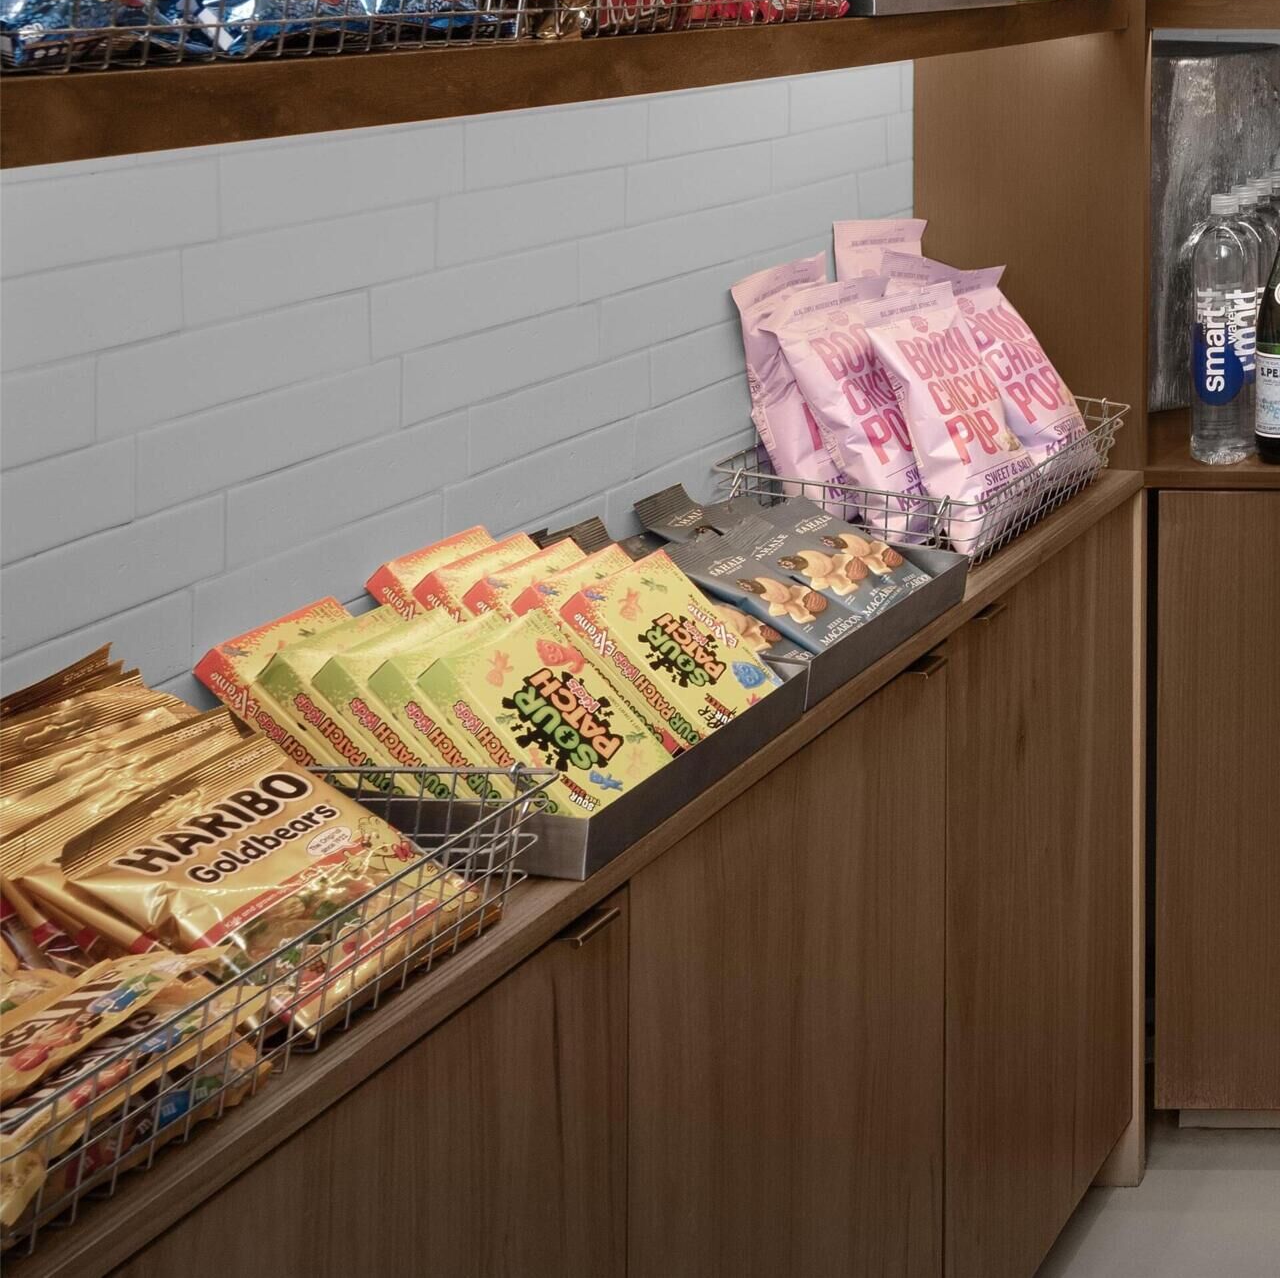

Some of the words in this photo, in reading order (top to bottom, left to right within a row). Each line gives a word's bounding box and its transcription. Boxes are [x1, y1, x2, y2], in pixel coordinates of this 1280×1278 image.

[897, 326, 980, 380] BOOM
[928, 368, 999, 416] CHICKA
[945, 409, 1000, 467] POP
[985, 468, 1010, 486] SWEET
[796, 514, 833, 534] SAHALE
[709, 555, 747, 577] SAHALE
[656, 612, 727, 681] PATCH
[820, 614, 863, 646] MACAROON
[613, 651, 640, 680] Kids
[645, 625, 710, 687] SOUR
[294, 692, 325, 725] Kids
[566, 678, 601, 714] Kids
[633, 674, 673, 723] PATCH
[257, 711, 287, 744] Kids
[350, 698, 381, 731] Kids
[405, 701, 438, 734] Kids
[453, 700, 484, 733] Kids
[514, 685, 600, 770] SOUR
[528, 668, 625, 762] PATCH
[318, 718, 369, 768] PATCH
[570, 791, 594, 812] SOUR
[114, 773, 309, 873] HARIBO
[188, 804, 337, 883] Goldbears
